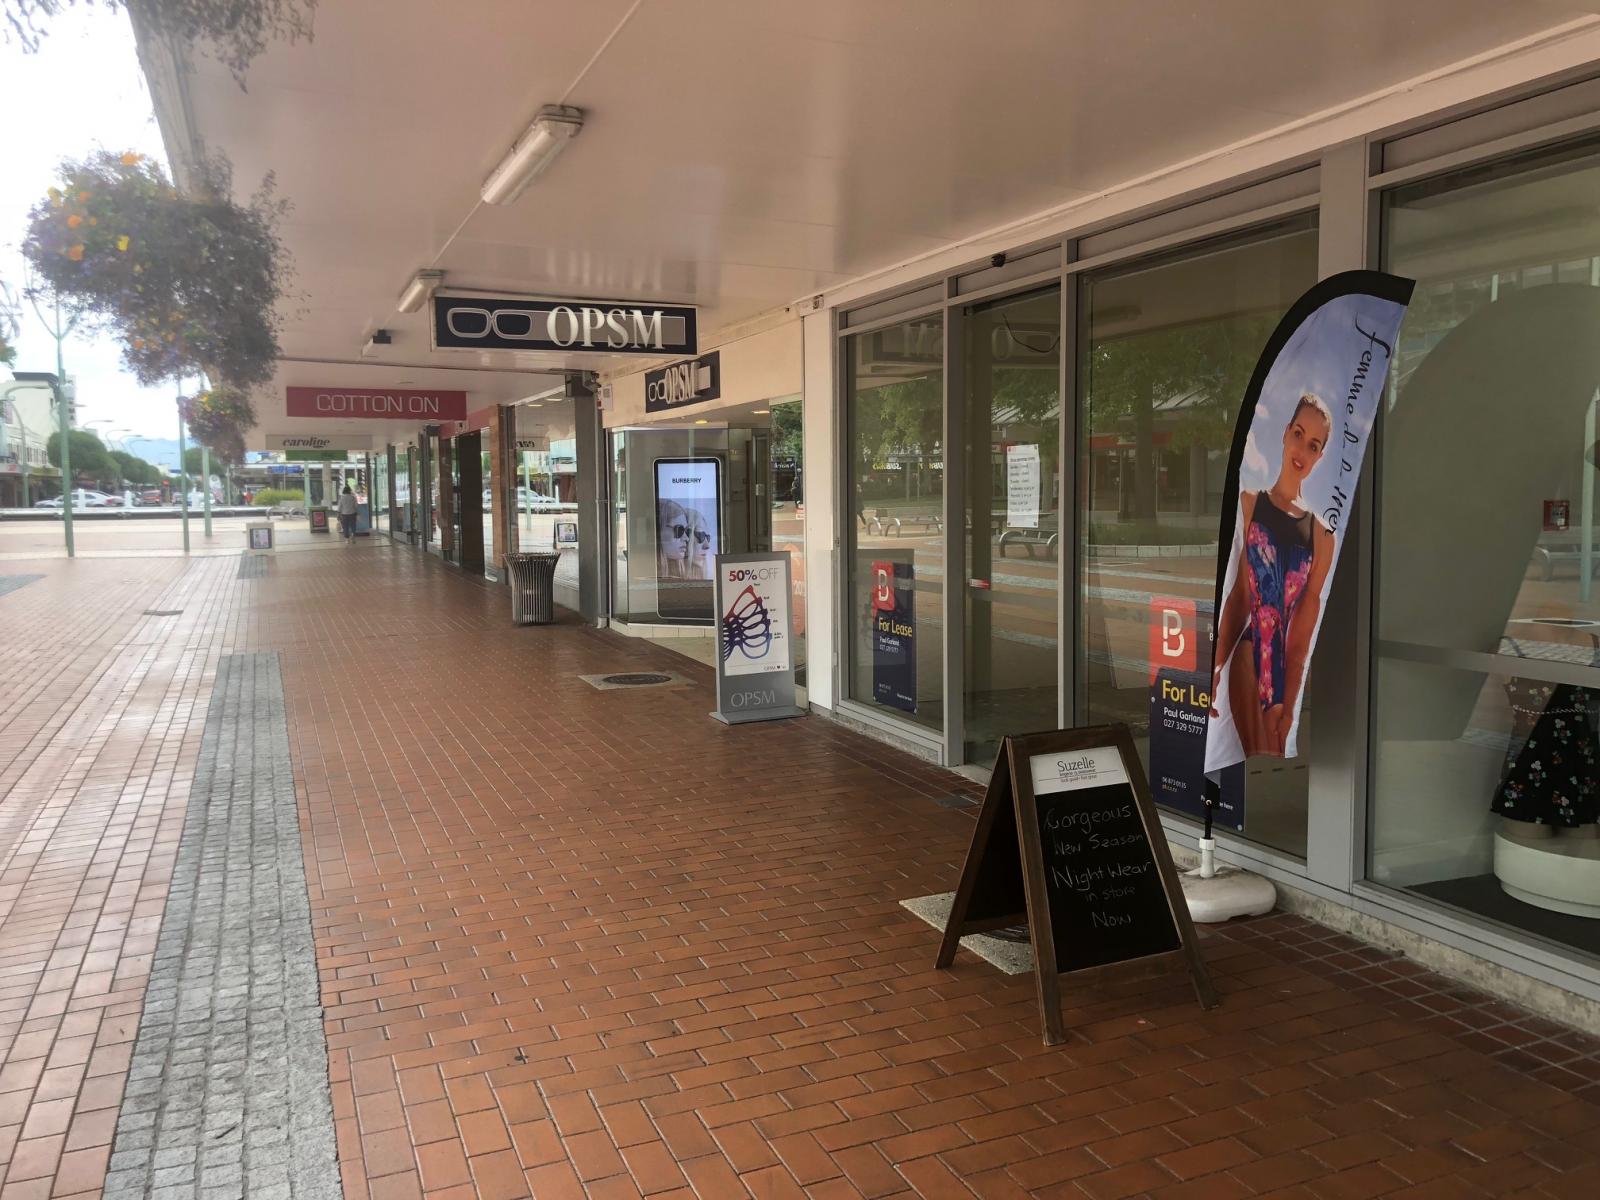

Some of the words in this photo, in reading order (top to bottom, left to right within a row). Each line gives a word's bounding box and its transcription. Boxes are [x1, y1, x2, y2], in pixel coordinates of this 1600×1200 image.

[547, 305, 666, 350] OPSM
[1345, 311, 1391, 415] femme
[664, 362, 699, 404] OPSM
[316, 394, 403, 413] COTTON
[409, 396, 439, 413] ON
[282, 437, 330, 448] caroline
[728, 569, 758, 582] 50%
[758, 567, 779, 581] OFF
[878, 617, 890, 633] For
[891, 619, 913, 638] Lease
[1162, 609, 1185, 657] B
[730, 690, 776, 708] OPSM
[1162, 679, 1186, 703] For
[1163, 707, 1178, 718] Paul
[1179, 711, 1206, 725] Garland
[1163, 719, 1175, 728] 027
[1176, 721, 1187, 732] 329
[1188, 724, 1203, 735] 5777
[1057, 757, 1096, 772] Suzelle
[1043, 805, 1131, 835] Gorgeous
[1055, 841, 1081, 855] New
[1089, 833, 1144, 849] Season
[1085, 892, 1098, 901] in
[1101, 886, 1136, 900] store
[1091, 911, 1131, 927] Now
